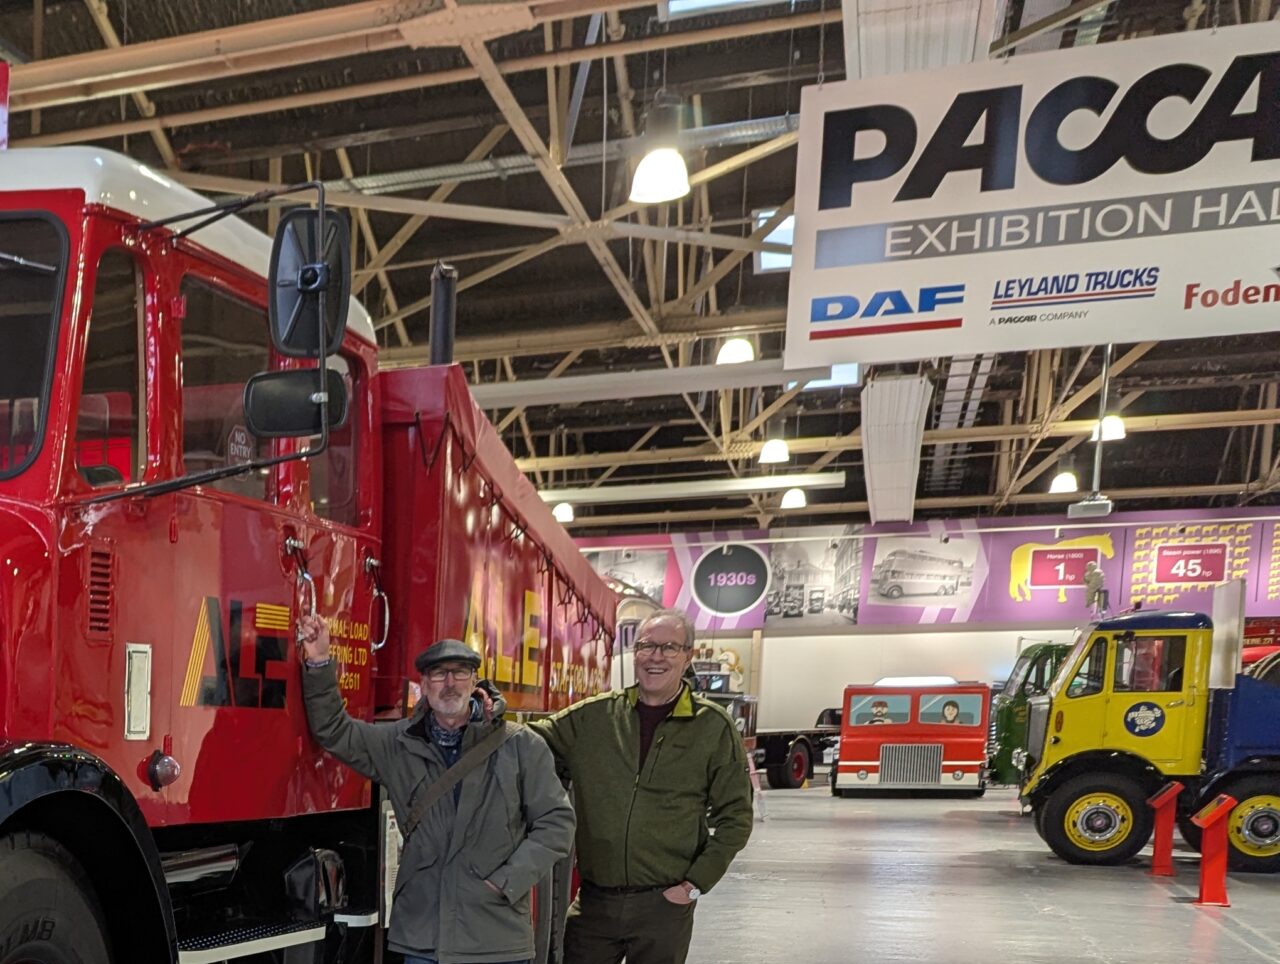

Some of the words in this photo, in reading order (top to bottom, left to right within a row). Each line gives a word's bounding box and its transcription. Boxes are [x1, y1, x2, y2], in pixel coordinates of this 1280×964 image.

[884, 199, 1173, 258] EXHIBITION
[992, 273, 1079, 300] LEYLAND
[1084, 266, 1160, 292] TRUCKS
[810, 283, 966, 323] DAF
[1183, 279, 1280, 310] Foden
[989, 318, 997, 326] A
[997, 315, 1038, 325] PACCAR
[1039, 310, 1090, 322] COMPANY
[235, 431, 246, 444] NO
[230, 443, 251, 458] ENTRY
[1053, 561, 1066, 581] 1
[1170, 558, 1203, 578] 45
[707, 571, 757, 588] 1930s
[349, 621, 369, 641] LOAD
[353, 647, 368, 667] LTD
